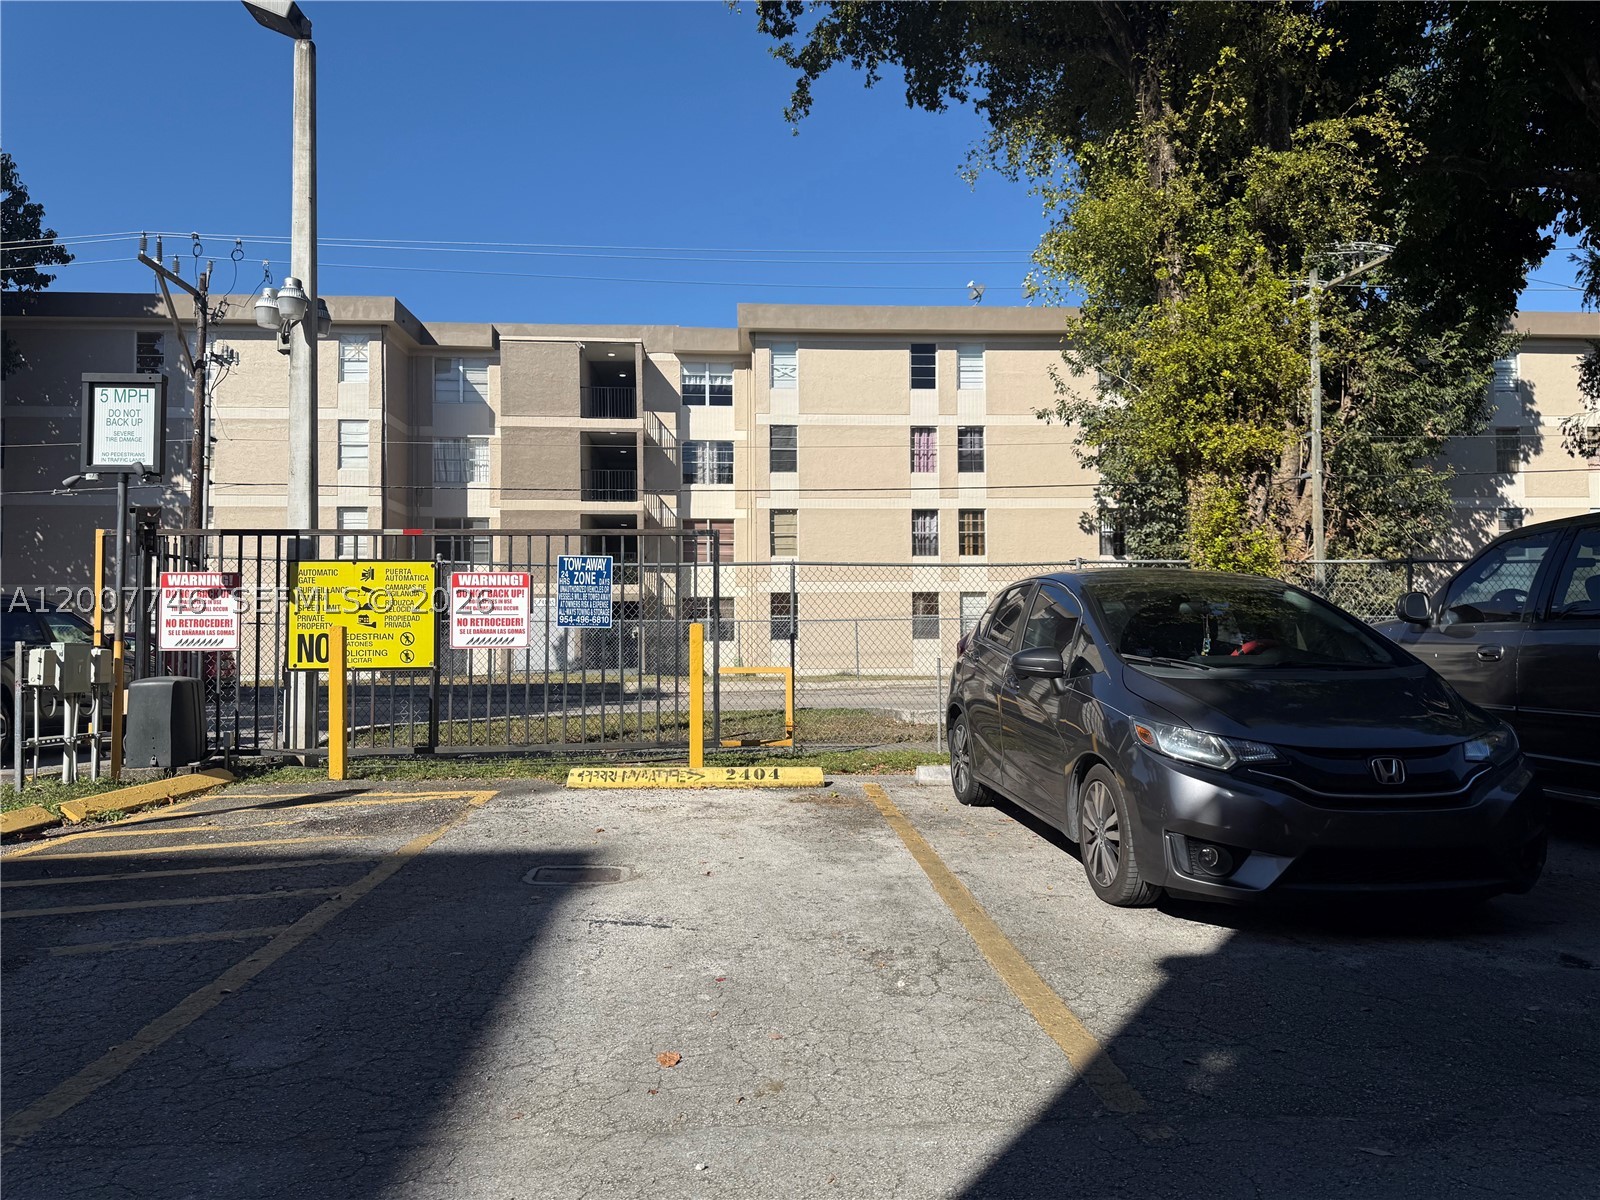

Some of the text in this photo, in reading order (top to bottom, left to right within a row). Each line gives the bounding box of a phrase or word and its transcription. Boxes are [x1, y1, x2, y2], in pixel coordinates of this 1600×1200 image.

[100, 389, 149, 403] 5 MPH
[108, 409, 141, 418] DO NOT
[106, 418, 143, 426] BACK UP
[563, 558, 607, 571] TOW-AWAY
[168, 574, 233, 586] WARNING!
[458, 574, 523, 586] WARNING!
[574, 572, 596, 584] ZONE
[488, 589, 509, 598] BACK
[511, 589, 524, 598] UP!
[166, 619, 233, 628] NO RETROCEDER!
[457, 618, 524, 626] NO RETROCEDER!
[298, 633, 329, 663] NO
[726, 768, 780, 780] 2404
